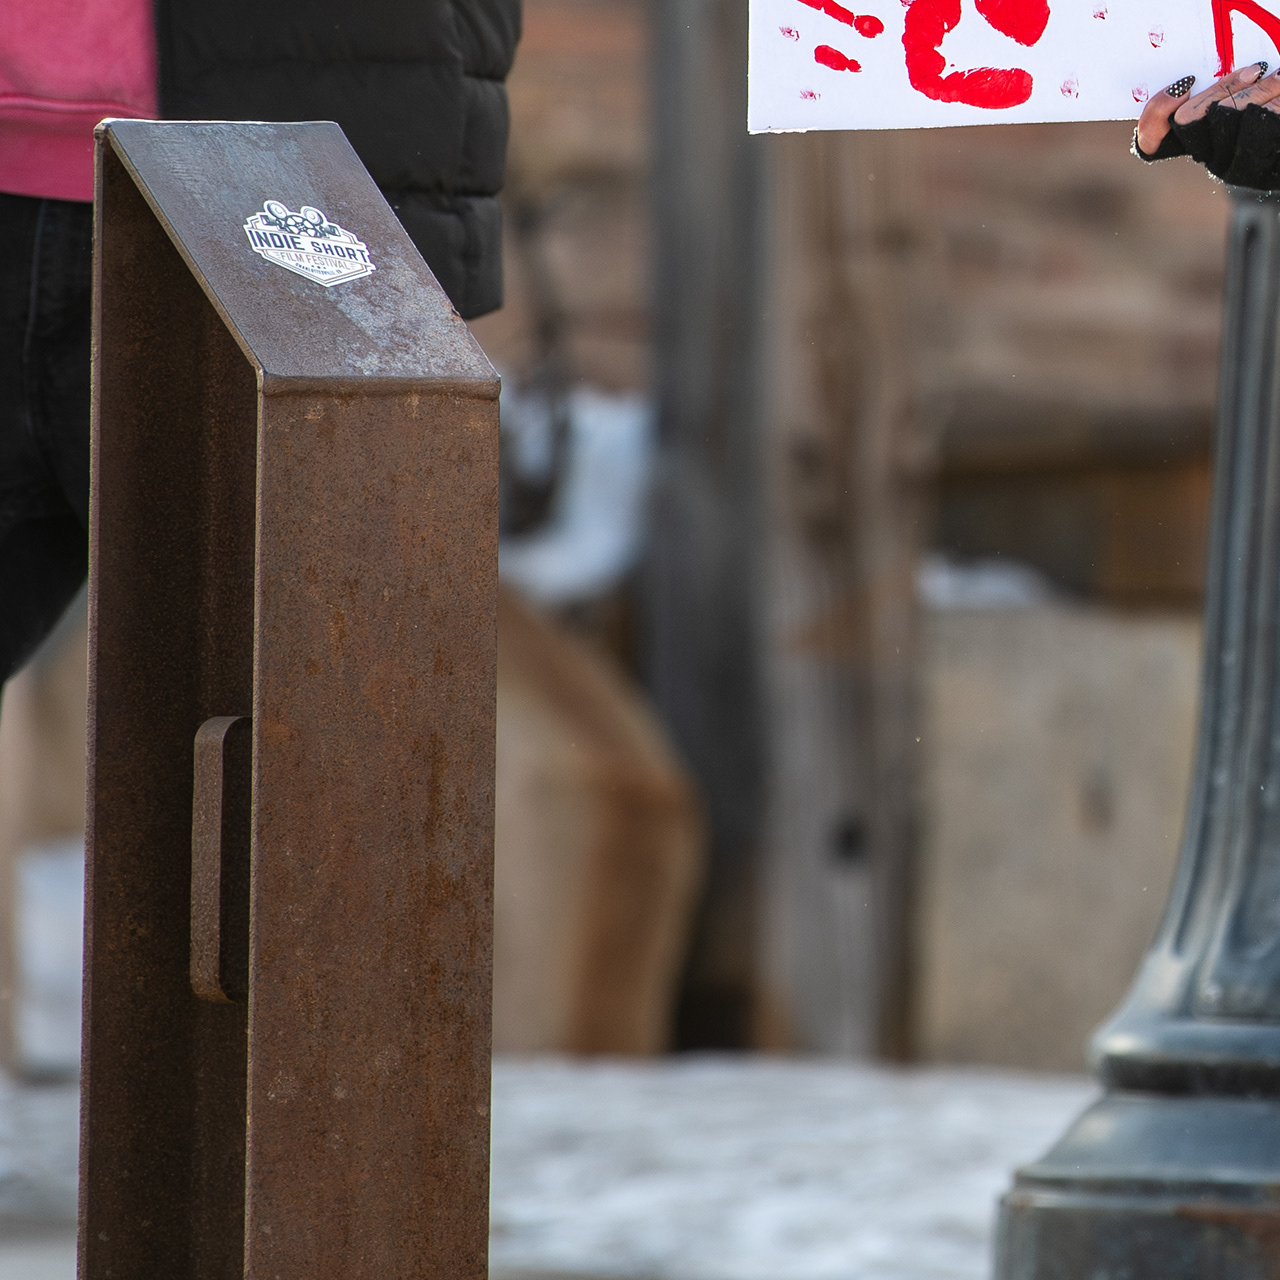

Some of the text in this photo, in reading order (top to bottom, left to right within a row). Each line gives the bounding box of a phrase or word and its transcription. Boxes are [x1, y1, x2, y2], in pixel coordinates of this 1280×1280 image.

[248, 230, 368, 264] INDIE SHORT
[280, 251, 351, 270] FILM FESTIVAL
